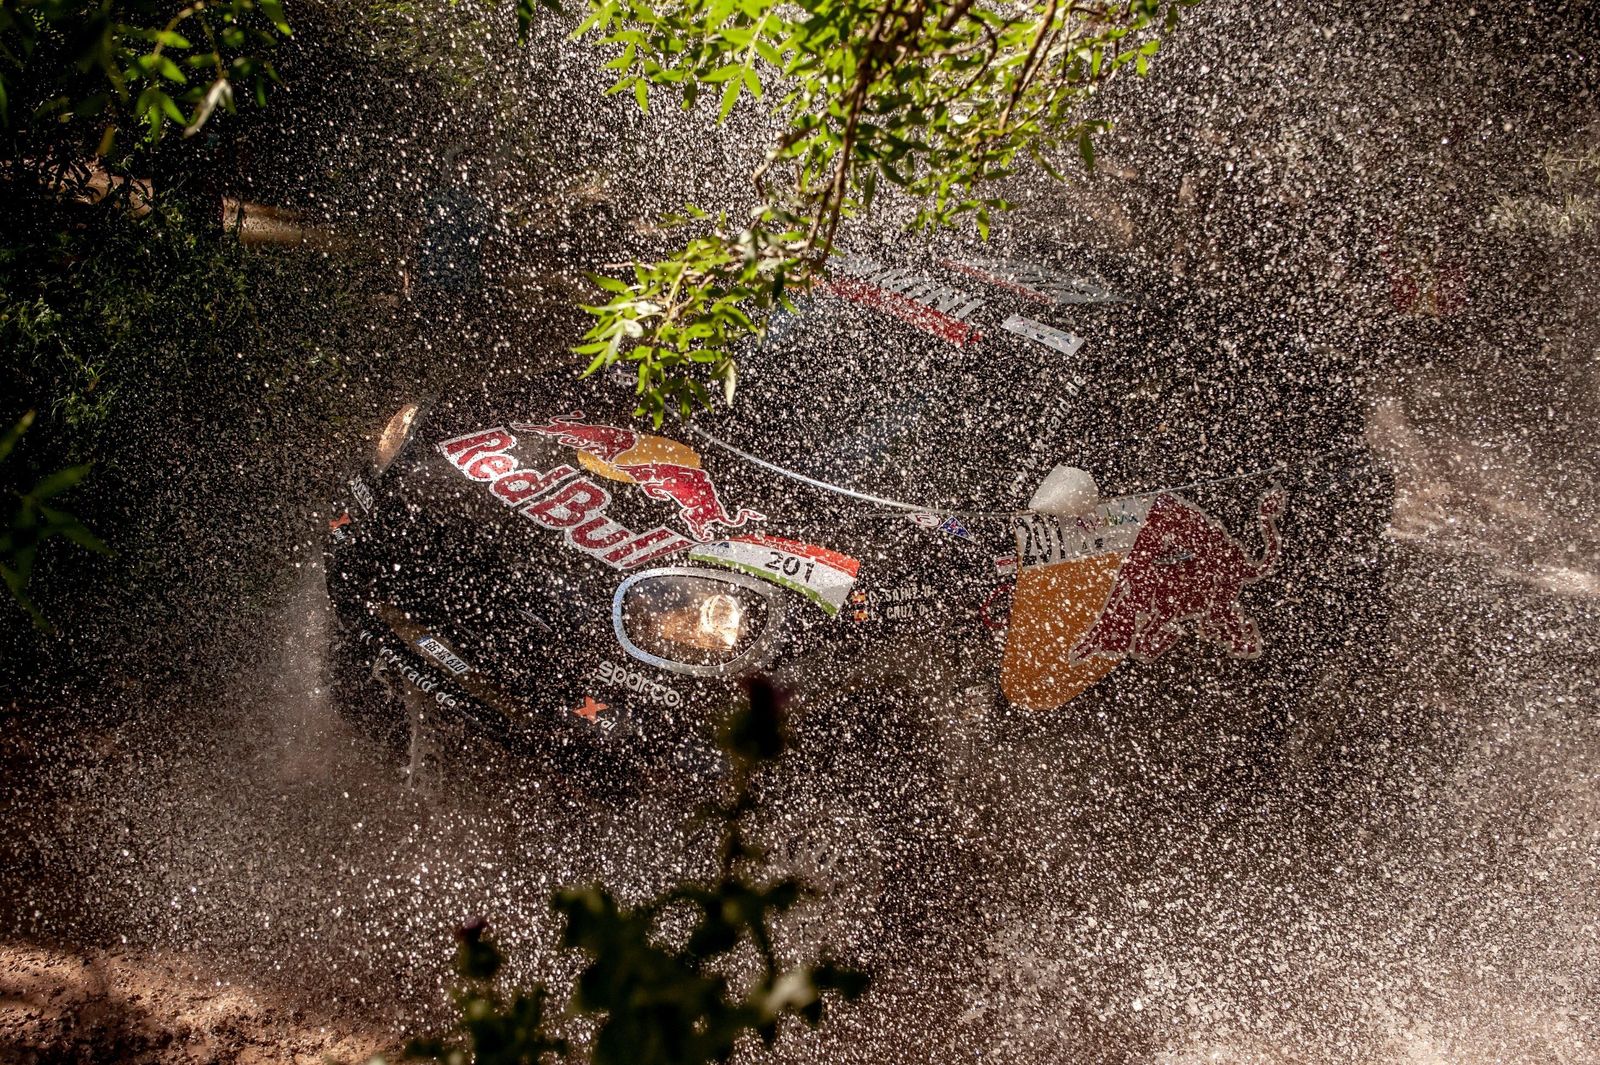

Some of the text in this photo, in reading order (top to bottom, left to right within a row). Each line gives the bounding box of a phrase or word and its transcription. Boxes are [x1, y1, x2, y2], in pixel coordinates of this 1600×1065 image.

[1013, 514, 1066, 567] 201
[765, 551, 815, 584] 201
[884, 587, 919, 603] SAINZ
[886, 603, 914, 621] CRUZ
[595, 660, 680, 707] sparco
